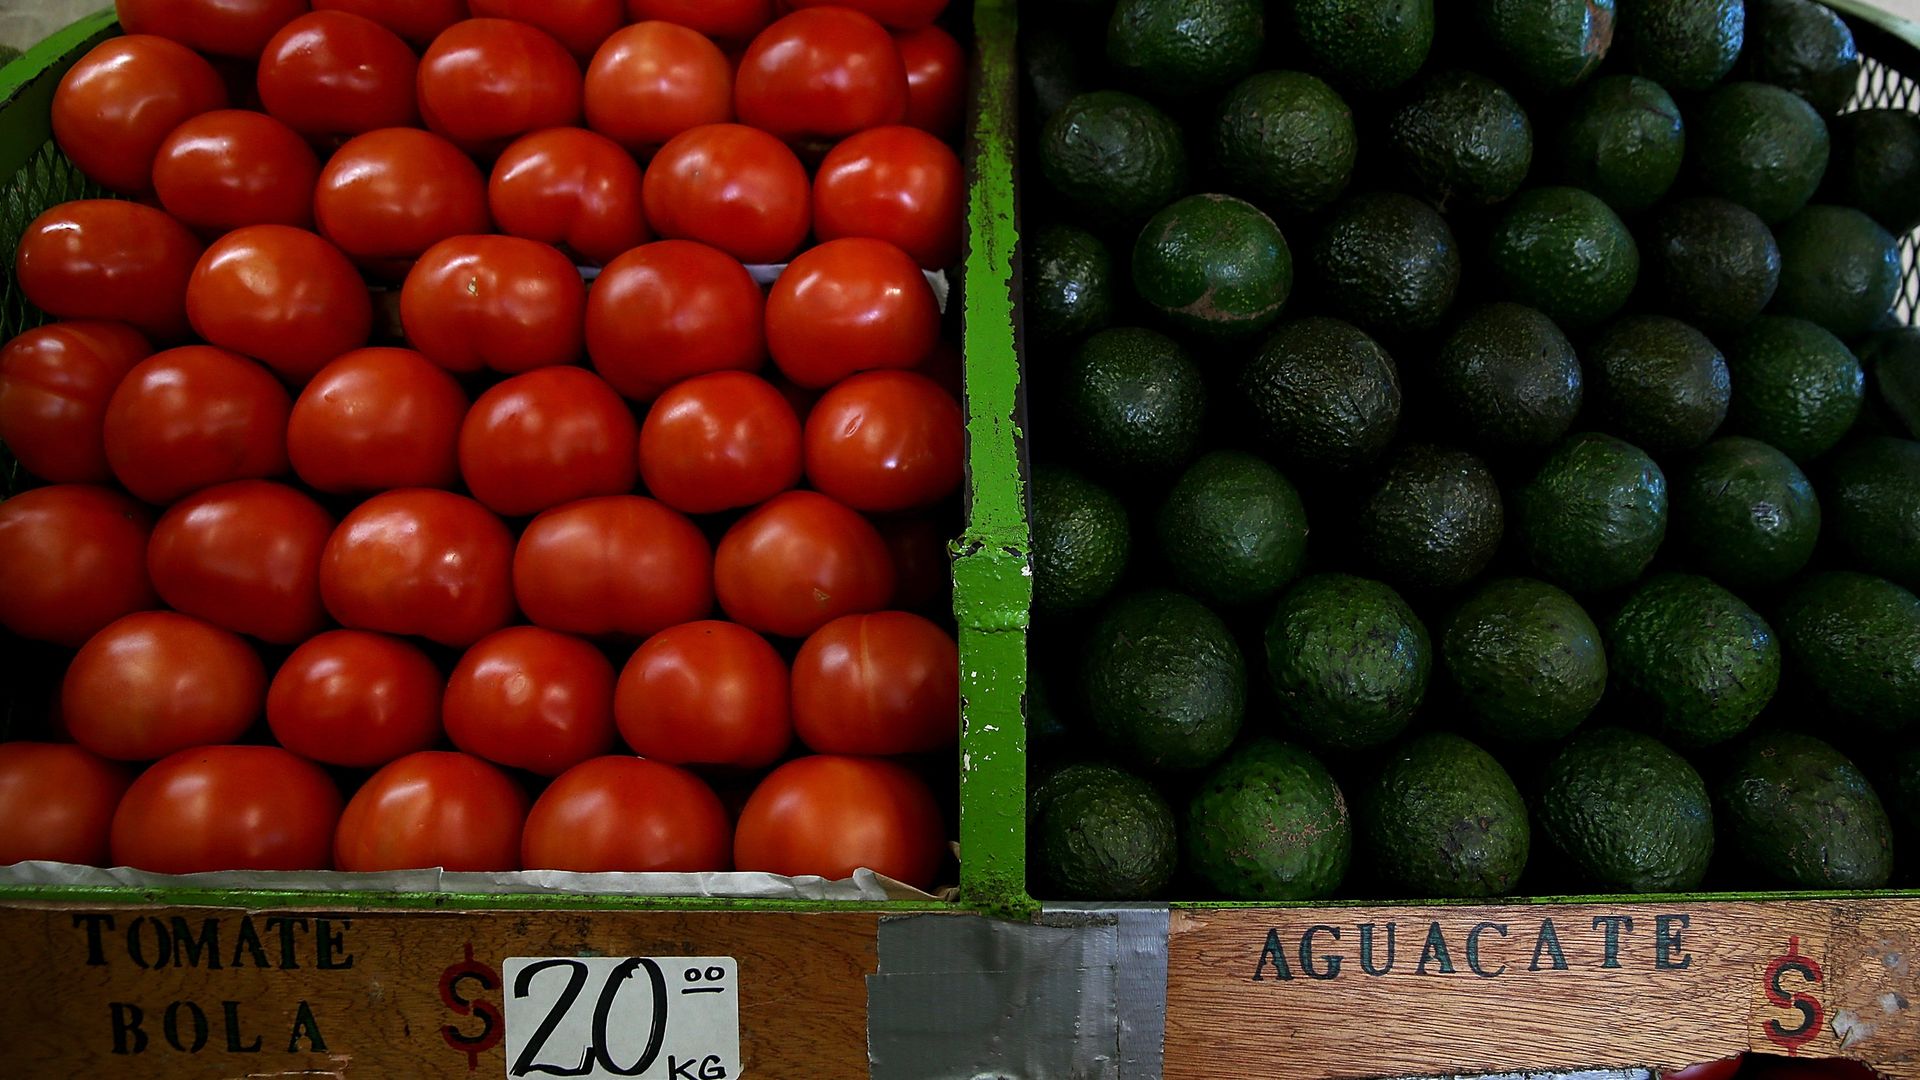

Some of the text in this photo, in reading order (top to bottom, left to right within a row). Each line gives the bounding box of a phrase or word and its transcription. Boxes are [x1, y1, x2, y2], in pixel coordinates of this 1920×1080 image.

[72, 914, 353, 970] TOMATE
[1252, 914, 1691, 981] AGUACATE
[439, 941, 505, 1071] $
[509, 958, 667, 1076] 20
[1764, 935, 1824, 1056] $
[108, 1000, 329, 1054] BOLA
[668, 1055, 726, 1080] KG
